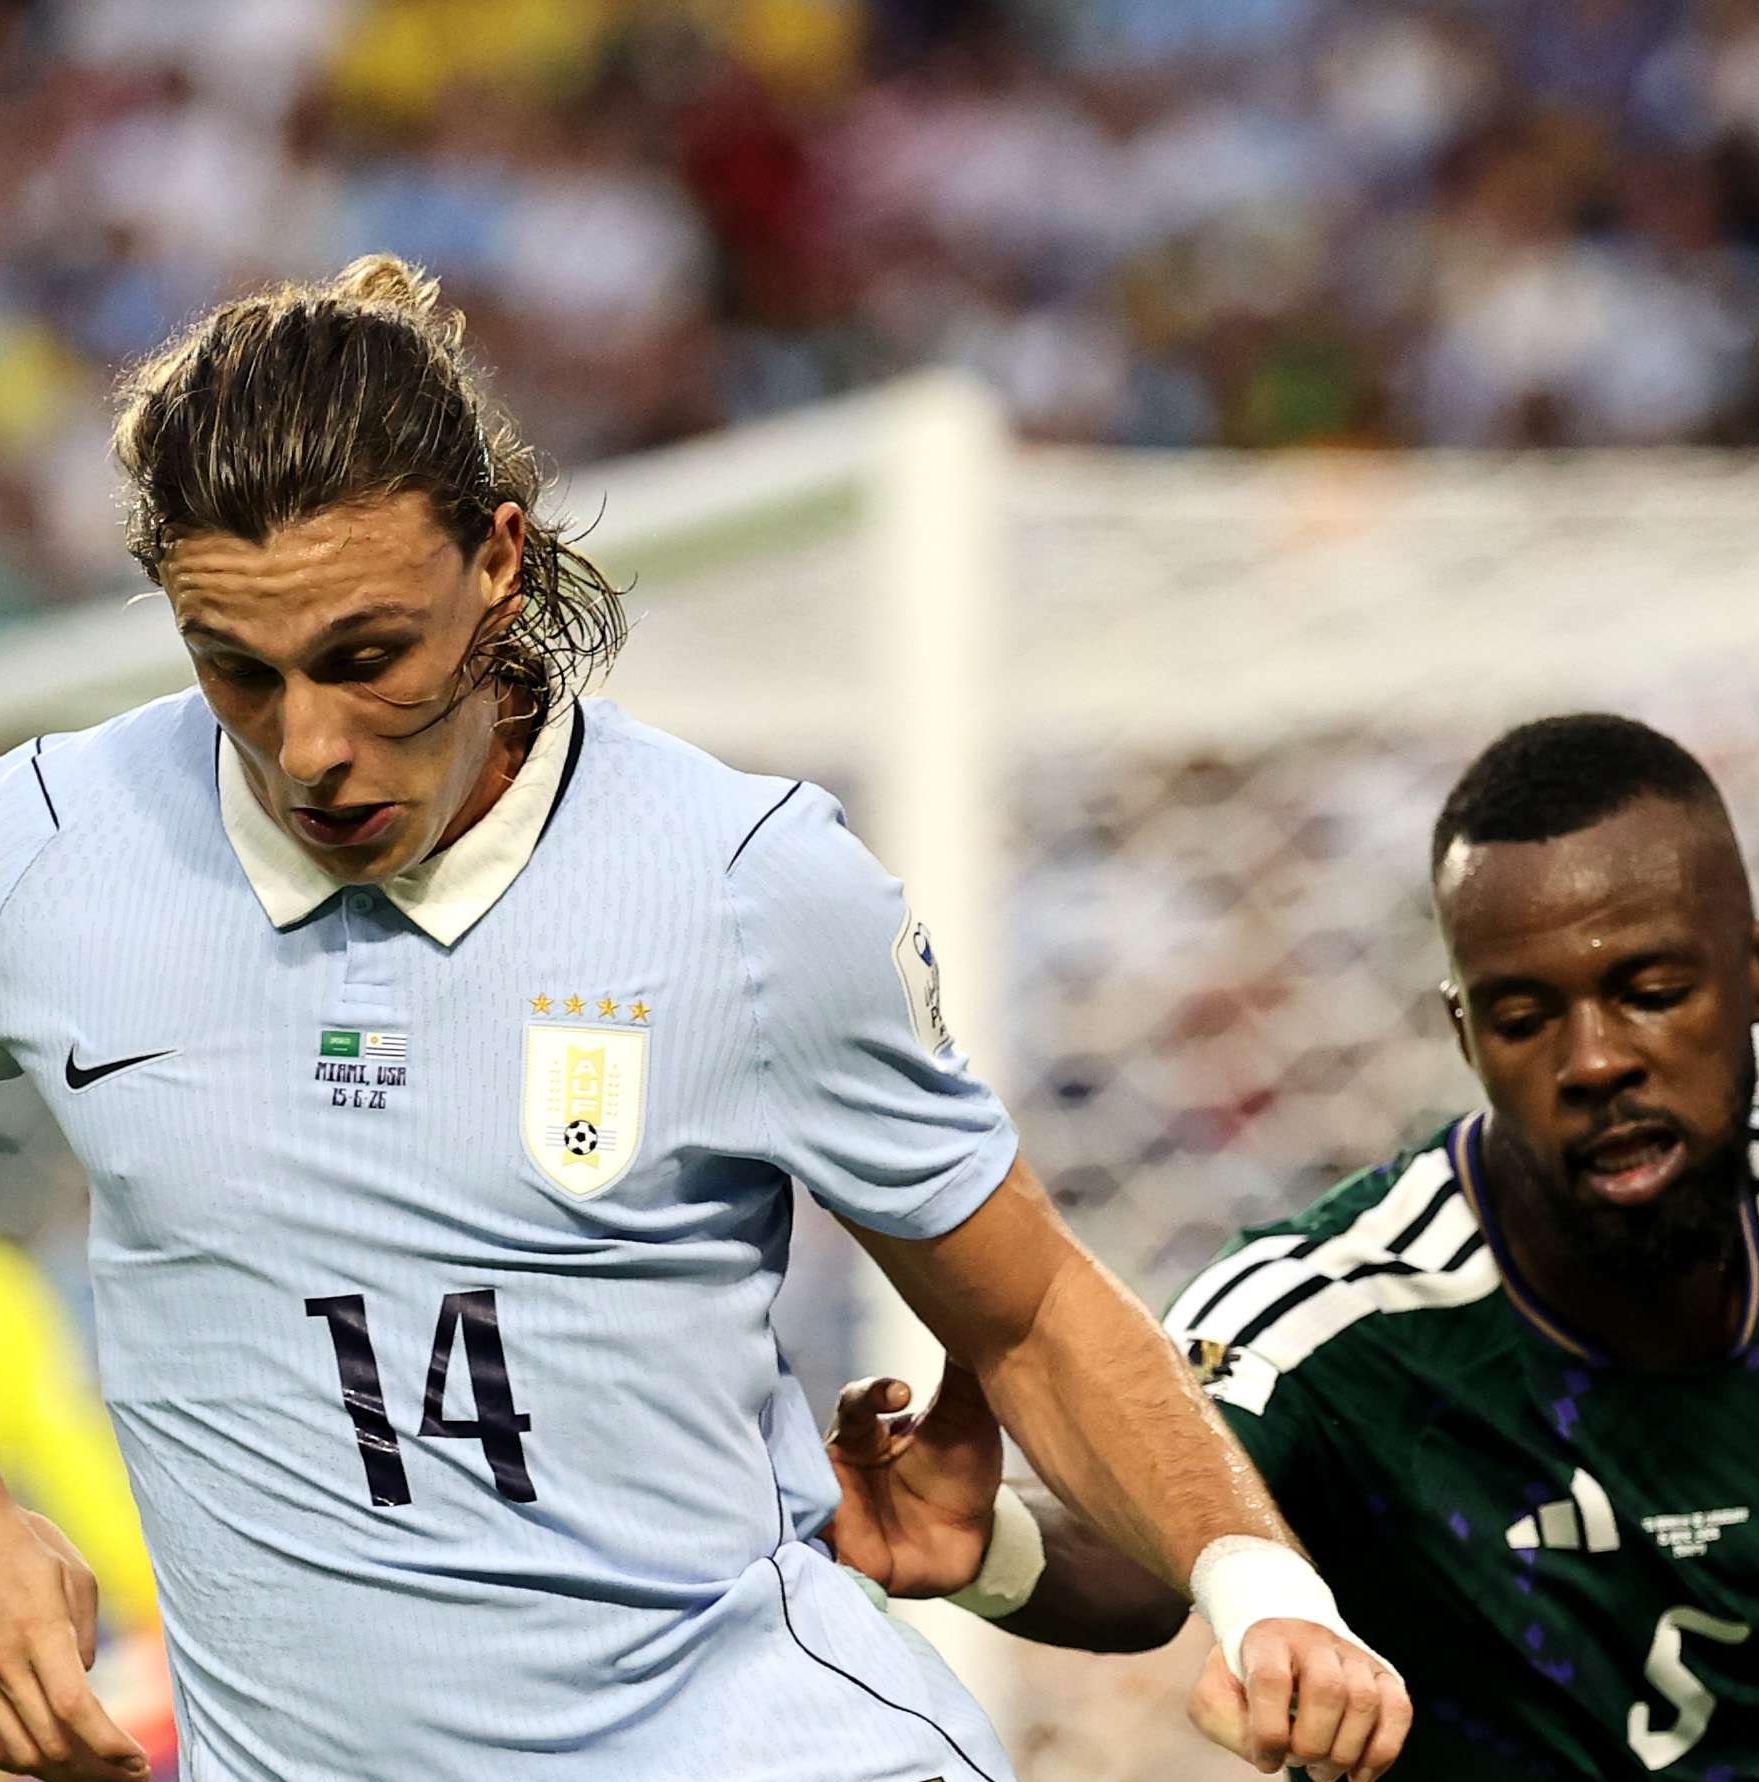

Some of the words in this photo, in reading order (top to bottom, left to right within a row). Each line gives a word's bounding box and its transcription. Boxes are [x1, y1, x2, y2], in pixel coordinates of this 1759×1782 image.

[315, 1061, 370, 1086] MIAMI,
[377, 1066, 406, 1086] USA
[304, 1289, 538, 1507] 14
[1627, 1605, 1751, 1772] 5
